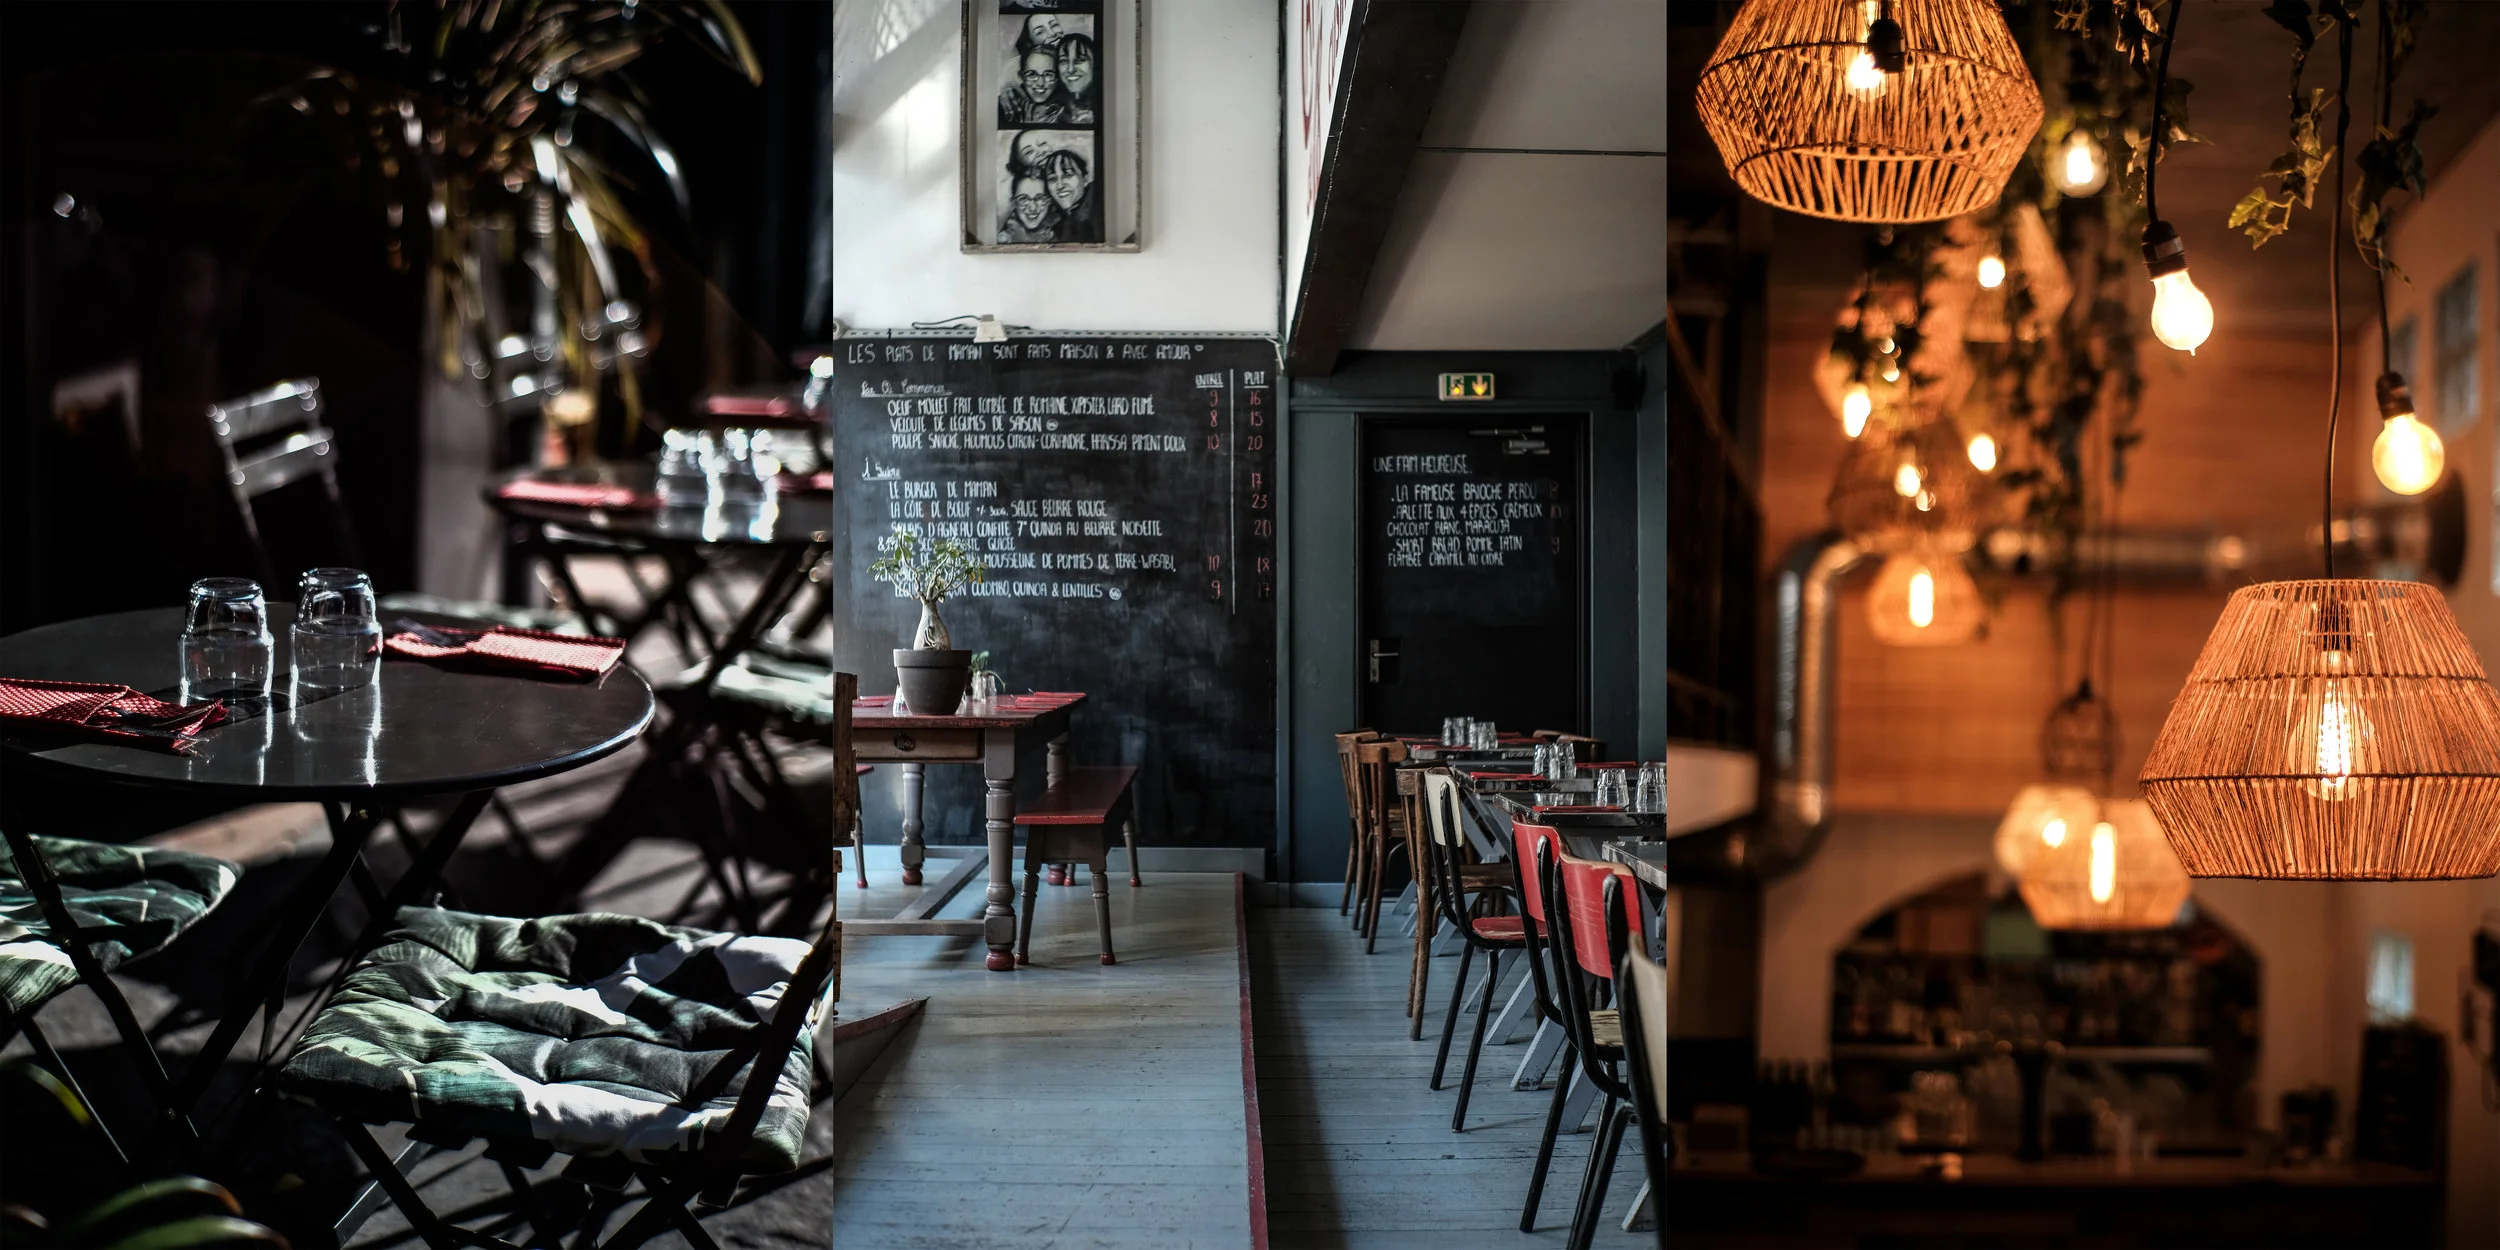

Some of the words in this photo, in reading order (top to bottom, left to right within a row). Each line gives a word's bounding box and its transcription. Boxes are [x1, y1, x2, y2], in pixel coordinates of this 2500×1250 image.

[848, 343, 876, 364] LES
[885, 344, 914, 362] PLATS
[922, 344, 936, 362] DE
[948, 344, 982, 360] MAMAN
[993, 344, 1019, 360] SONT
[1027, 344, 1051, 359] FAITS
[1060, 344, 1098, 359] MAISON
[1122, 344, 1149, 359] AVEC
[1156, 344, 1191, 360] AMOUR
[1244, 371, 1265, 386] PLAT
[917, 397, 948, 415] MOLLET
[1013, 396, 1024, 415] DE
[1210, 390, 1218, 407] 9
[1250, 391, 1261, 406] 16
[933, 416, 945, 432] DE
[992, 415, 1004, 432] DE
[1009, 415, 1042, 432] SAISON
[1210, 410, 1218, 427] 8
[1251, 410, 1263, 427] 15
[892, 434, 922, 450] POULPE
[964, 434, 1005, 450] HOUMOUS
[1132, 434, 1161, 451] PIMENT
[1164, 435, 1186, 452] DOUX
[1208, 434, 1220, 450] 10
[1248, 436, 1263, 451] 20
[1373, 456, 1394, 473] UNE
[1397, 455, 1418, 472] FAIM
[1251, 473, 1262, 489] 17
[889, 481, 900, 499] LE
[904, 481, 937, 499] BURGER
[947, 481, 958, 498] DE
[964, 481, 998, 498] MAMAN
[1414, 484, 1455, 501] FAMEUSE
[1463, 482, 1502, 501] BRIOCHE
[891, 501, 900, 519] LA
[931, 501, 941, 518] DE
[1010, 500, 1038, 518] SAUCE
[1042, 499, 1073, 517] BEURRE
[1077, 500, 1108, 517] ROUGE
[1252, 493, 1268, 509] 23
[1436, 504, 1456, 520] AUX
[1460, 505, 1468, 519] 4
[977, 521, 1011, 537] CONFITE
[1030, 520, 1062, 538] QUINOA
[1066, 521, 1079, 536] AU
[1084, 521, 1117, 536] BEURRE
[1122, 520, 1163, 536] NOISETTE
[1255, 520, 1271, 536] 20
[1387, 521, 1430, 536] CHOCOLAT
[1432, 536, 1460, 553] BREAD
[1466, 536, 1493, 552] POMME
[1500, 535, 1522, 551] TATIN
[1042, 553, 1053, 569] DE
[1057, 553, 1094, 569] POMMES
[1098, 554, 1110, 569] DE
[1209, 555, 1220, 571] 10
[1257, 557, 1270, 572] 18
[1429, 550, 1464, 567] CARAMEL
[1468, 553, 1479, 566] AU
[1481, 552, 1504, 567] CIDRE
[1013, 582, 1047, 598] QUINOA
[1052, 583, 1059, 597] &
[1062, 583, 1103, 598] LENTILLES
[1211, 580, 1220, 599] 9
